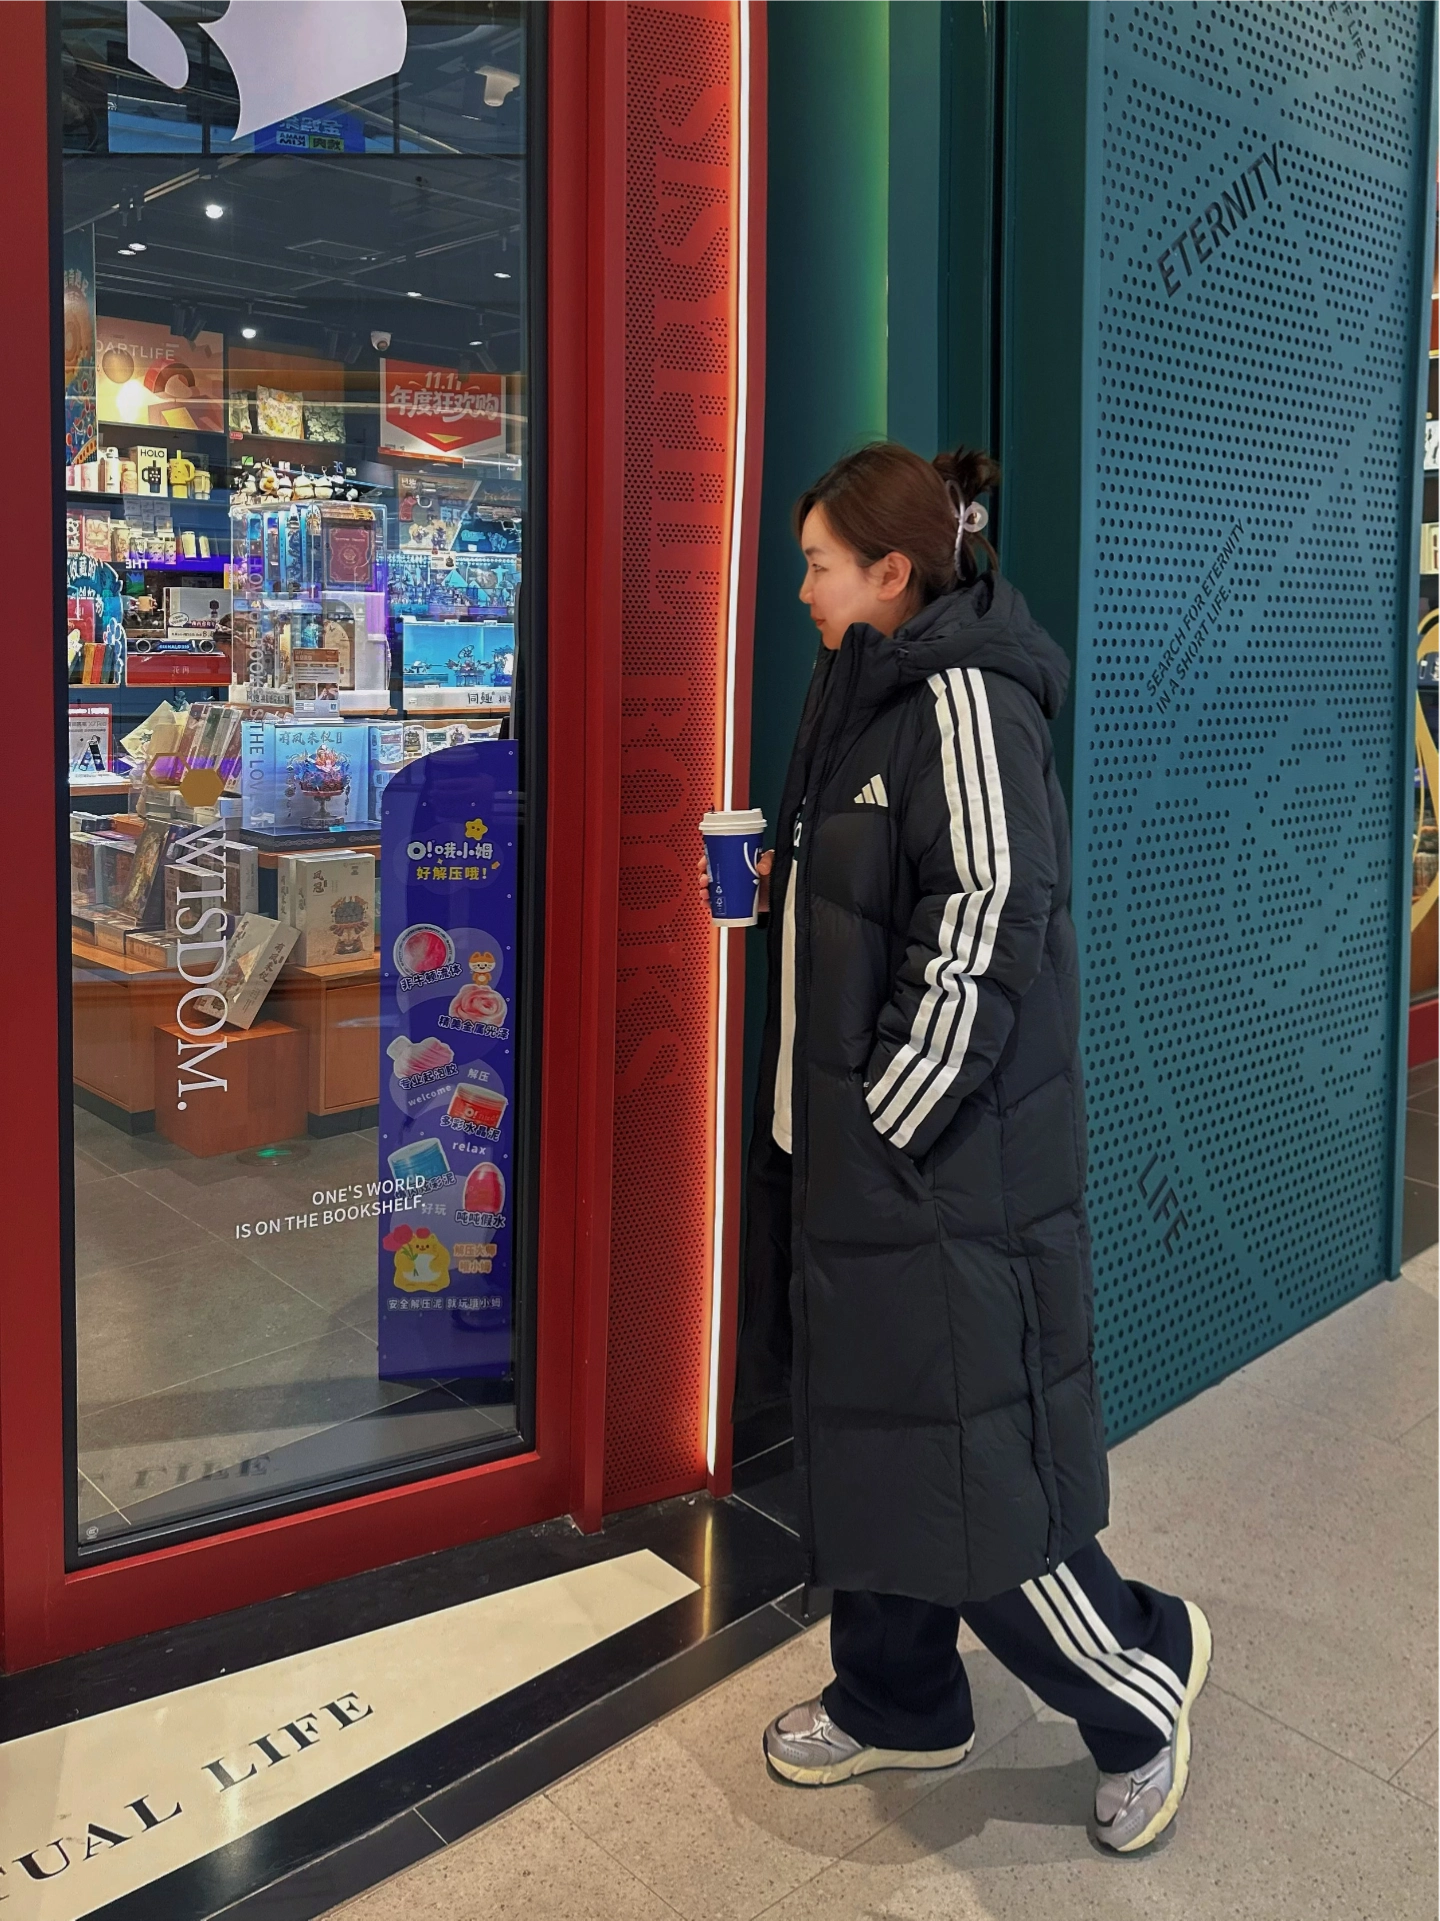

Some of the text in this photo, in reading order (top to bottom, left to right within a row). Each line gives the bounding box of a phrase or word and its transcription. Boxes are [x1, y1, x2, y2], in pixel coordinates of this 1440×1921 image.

[1348, 20, 1367, 70] LIFE,
[1156, 142, 1283, 298] ETERNITY
[390, 384, 499, 423] 年度狂欢购
[140, 448, 165, 458] HOLO
[1146, 518, 1245, 697] SEARCH FOR ETERNITY
[1156, 585, 1232, 714] IN A SHORT LIFE.
[249, 721, 264, 755] THE
[614, 674, 692, 1087] BOOKS
[175, 817, 229, 1111] WISDOM.
[400, 962, 463, 992] 非牛顿流体
[438, 1014, 510, 1040] 精美金属光泽
[399, 1062, 459, 1090] 专业起泡胶
[467, 1067, 491, 1083] 解压
[407, 1084, 452, 1107] welcome
[440, 1114, 502, 1142] 多彩水晶泥
[452, 1140, 487, 1155] relax
[312, 1175, 426, 1206] ONE'S WORLD
[1136, 1152, 1189, 1258] LIFE
[235, 1194, 426, 1240] IS ON THE BOOKSHELF.
[456, 1210, 506, 1229] 吨吨假水
[0, 1691, 374, 1901] UAL LIFE
